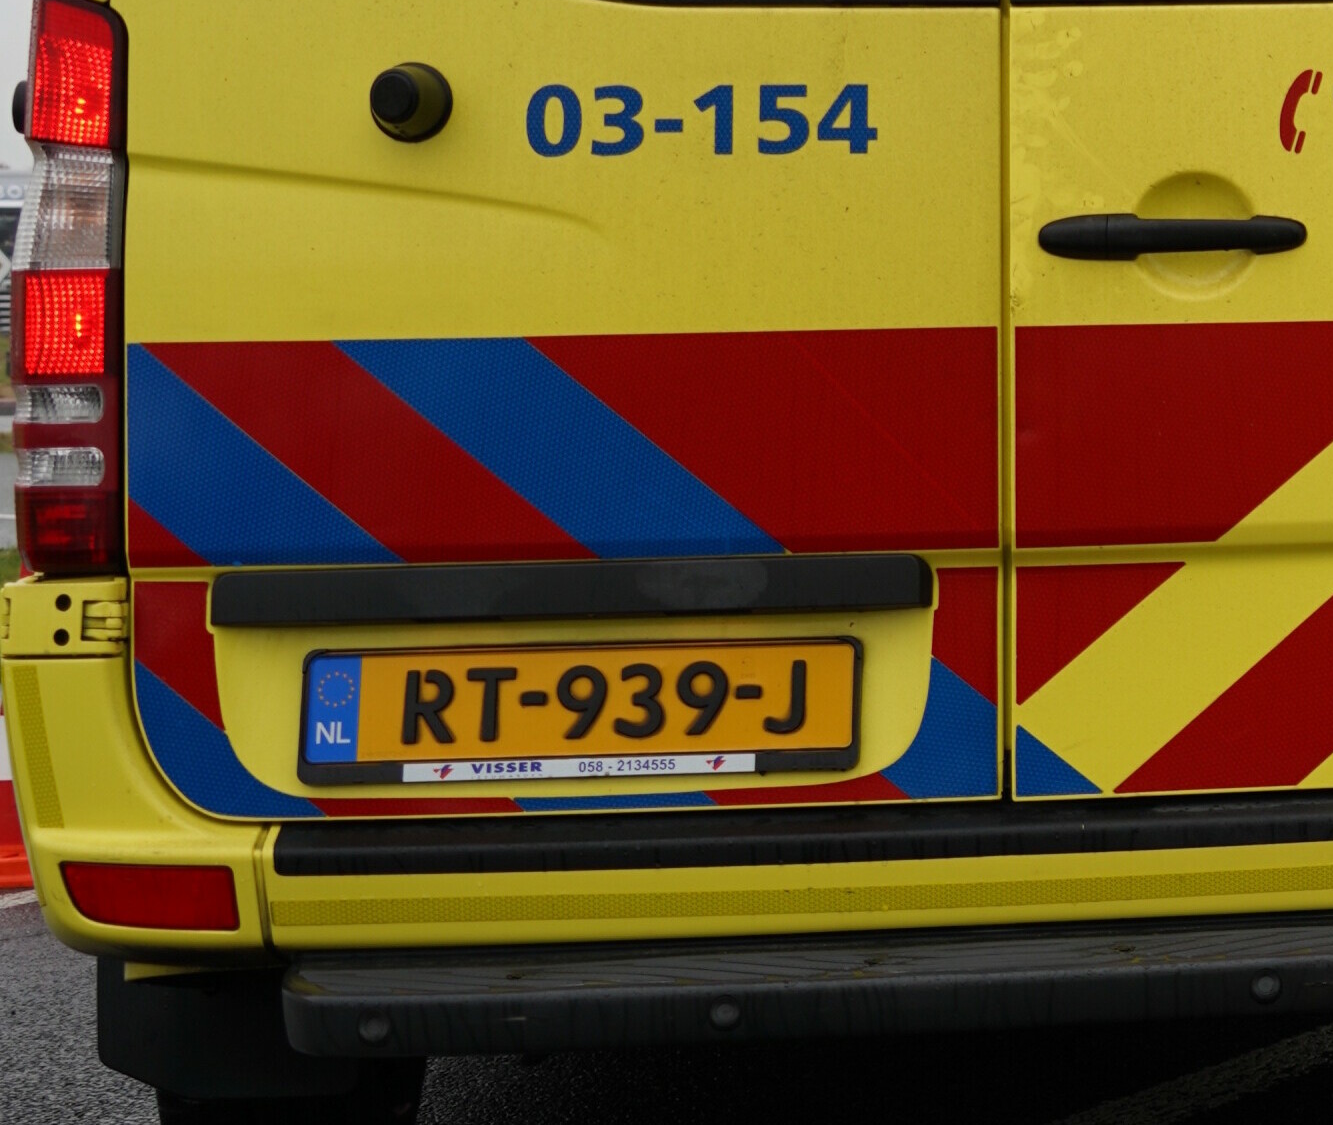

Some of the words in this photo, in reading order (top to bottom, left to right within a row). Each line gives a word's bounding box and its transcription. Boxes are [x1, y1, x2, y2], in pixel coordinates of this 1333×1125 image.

[526, 83, 878, 157] 03-154
[401, 659, 808, 746] RT-939-J
[315, 722, 351, 745] NL
[471, 761, 543, 773] VISSER
[578, 761, 603, 773] 058
[616, 759, 676, 772] 2134555
